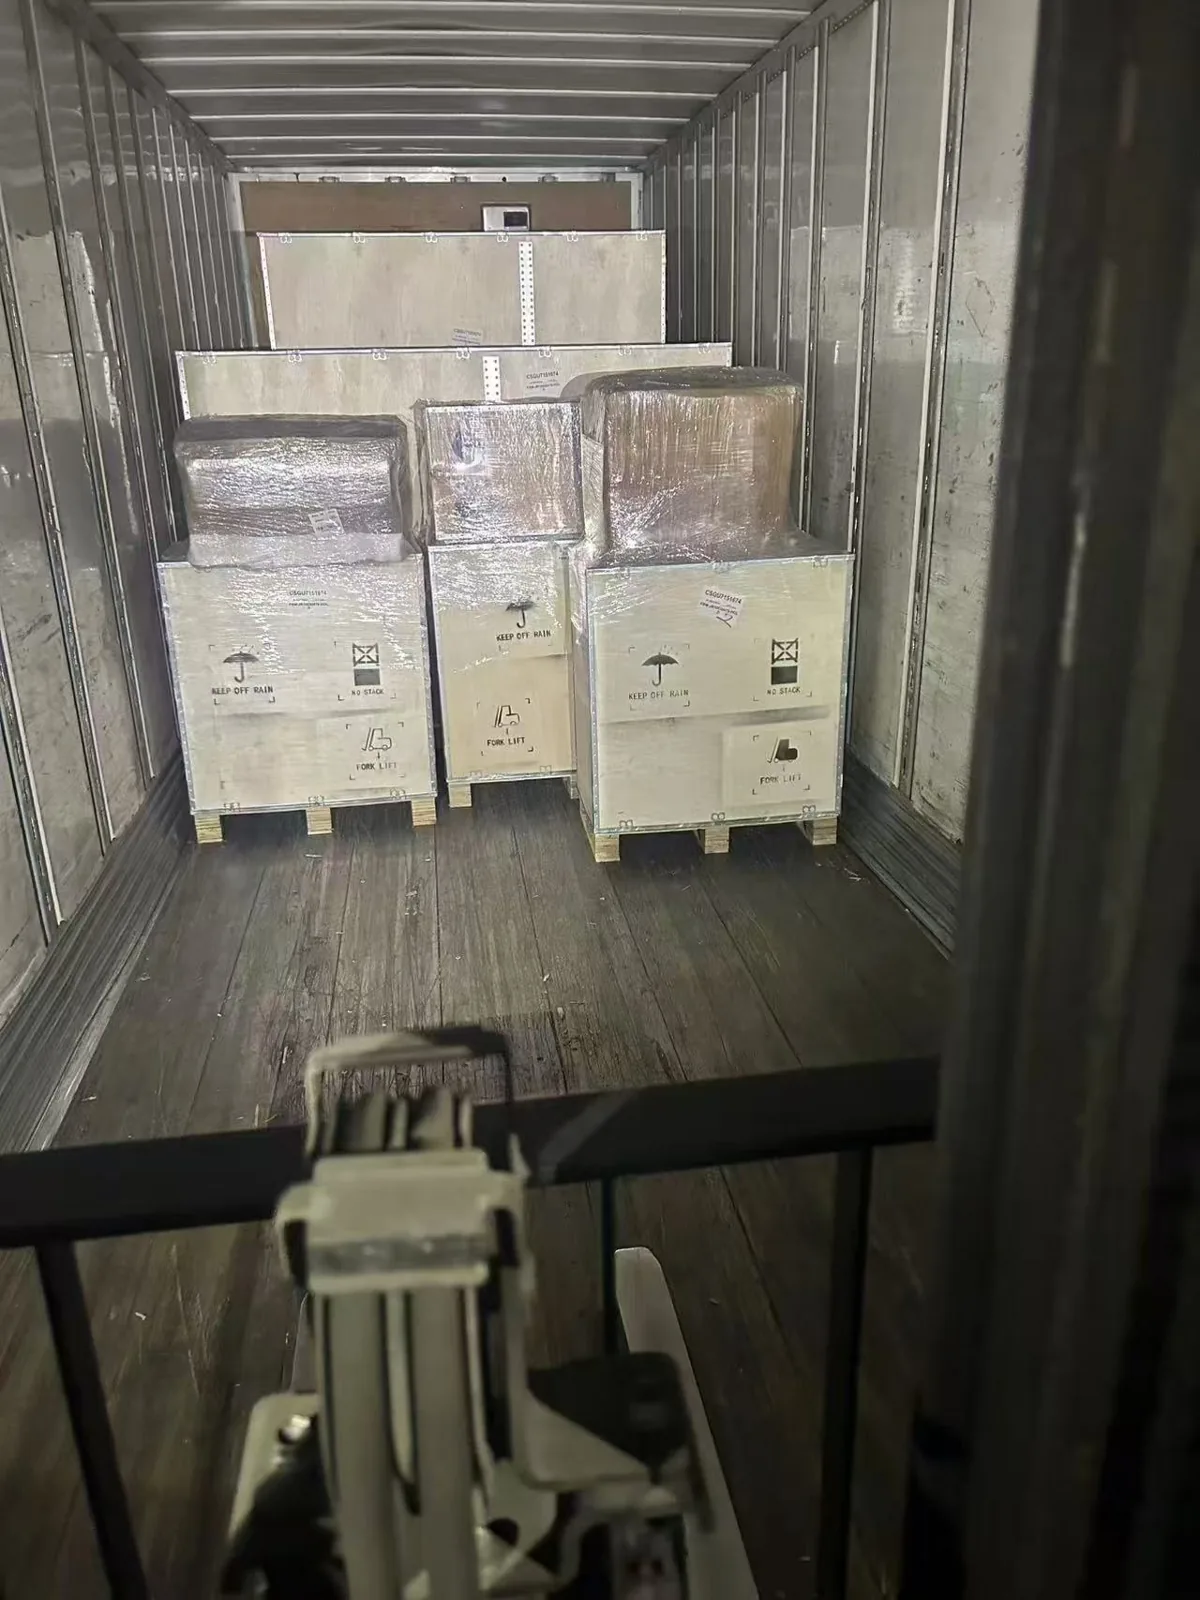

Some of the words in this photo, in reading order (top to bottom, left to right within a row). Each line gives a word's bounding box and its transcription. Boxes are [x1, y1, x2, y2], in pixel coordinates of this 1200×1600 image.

[496, 633, 514, 641] KEEP
[516, 632, 530, 640] OFF
[533, 630, 551, 638] RAIN
[234, 686, 250, 695] OFF
[253, 685, 274, 694] RAIN
[363, 688, 385, 696] STACK
[628, 691, 648, 700] KEEP
[650, 690, 665, 699] OFF
[669, 689, 689, 698] RAIN
[486, 738, 506, 747] FORK
[508, 736, 526, 746] LIFT
[356, 762, 376, 771] FORK
[760, 775, 780, 785] FORK
